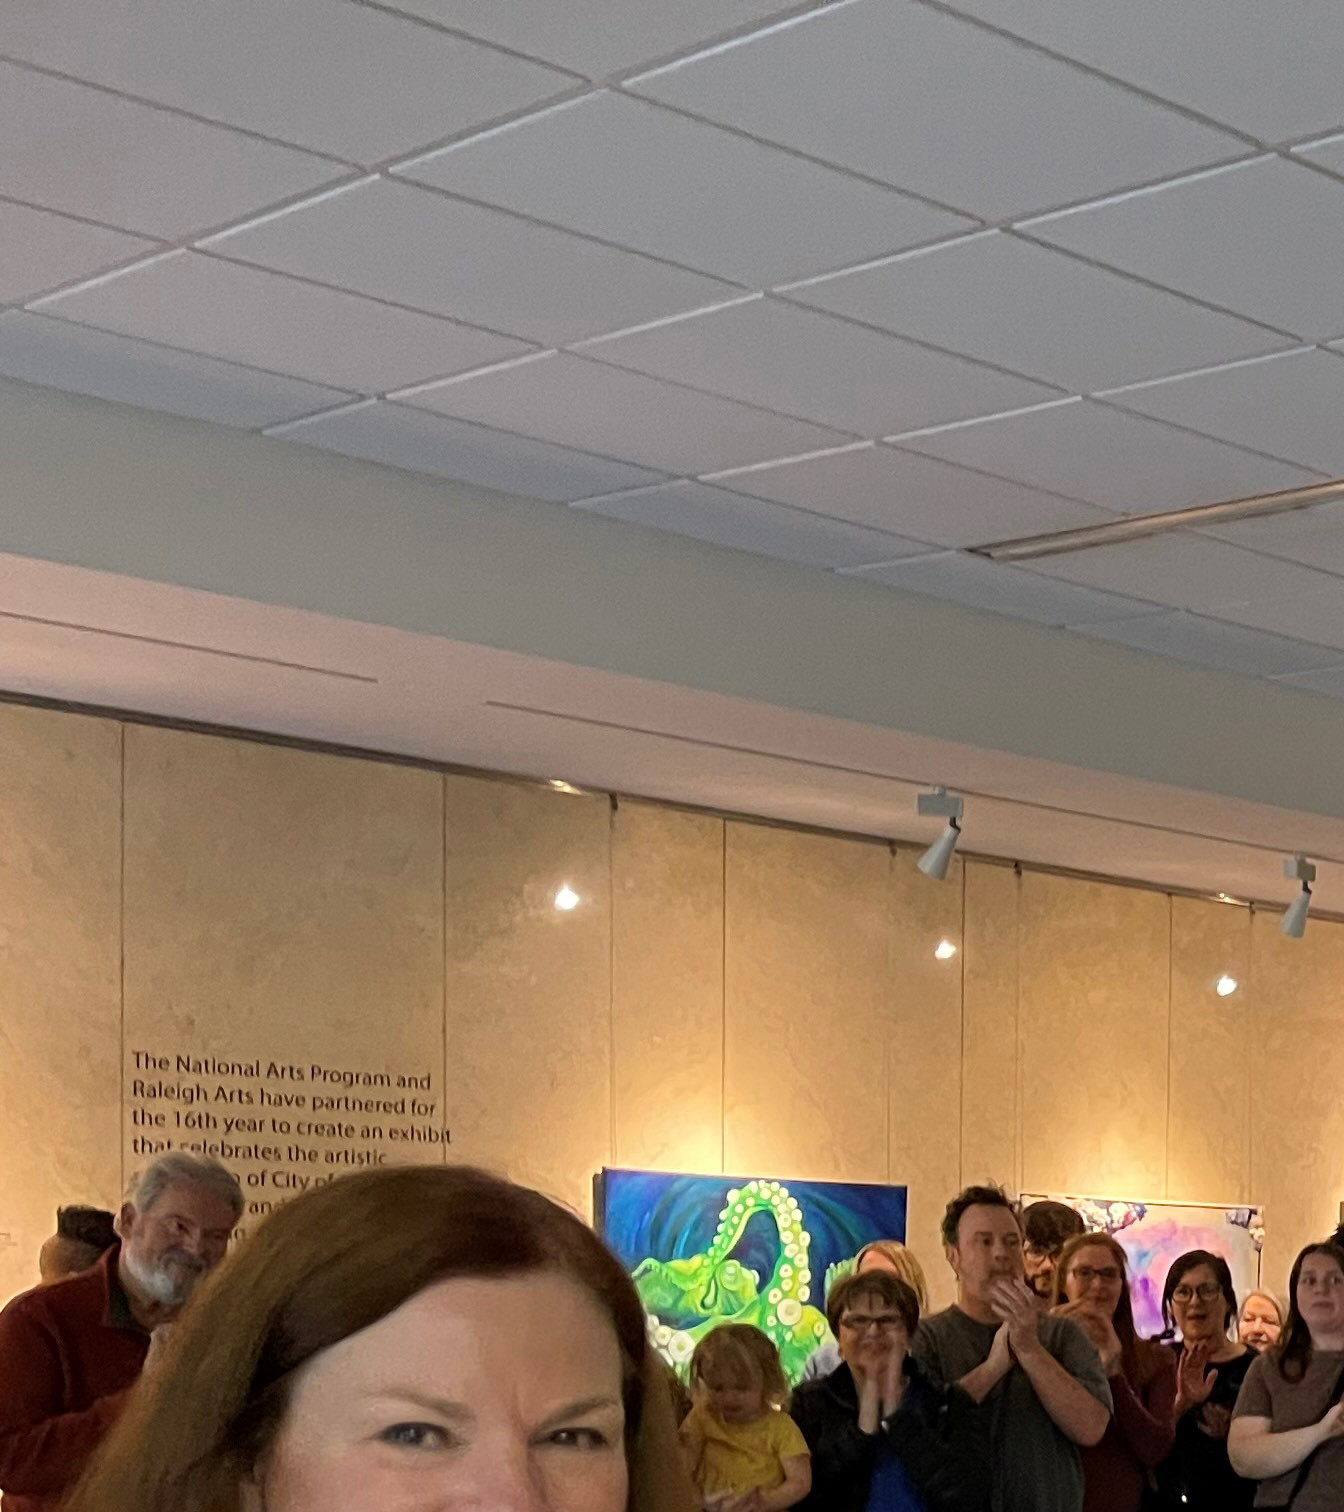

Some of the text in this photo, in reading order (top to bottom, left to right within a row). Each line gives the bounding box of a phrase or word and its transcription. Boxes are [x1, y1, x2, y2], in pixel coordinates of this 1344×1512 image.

[132, 1050, 431, 1091] The National Arts Program and
[133, 1079, 437, 1117] Raleigh Arts have partnered for
[133, 1108, 453, 1144] the 16th year to create an exhibit
[287, 1144, 319, 1163] the
[324, 1148, 388, 1165] artistic
[247, 1169, 268, 1188] of
